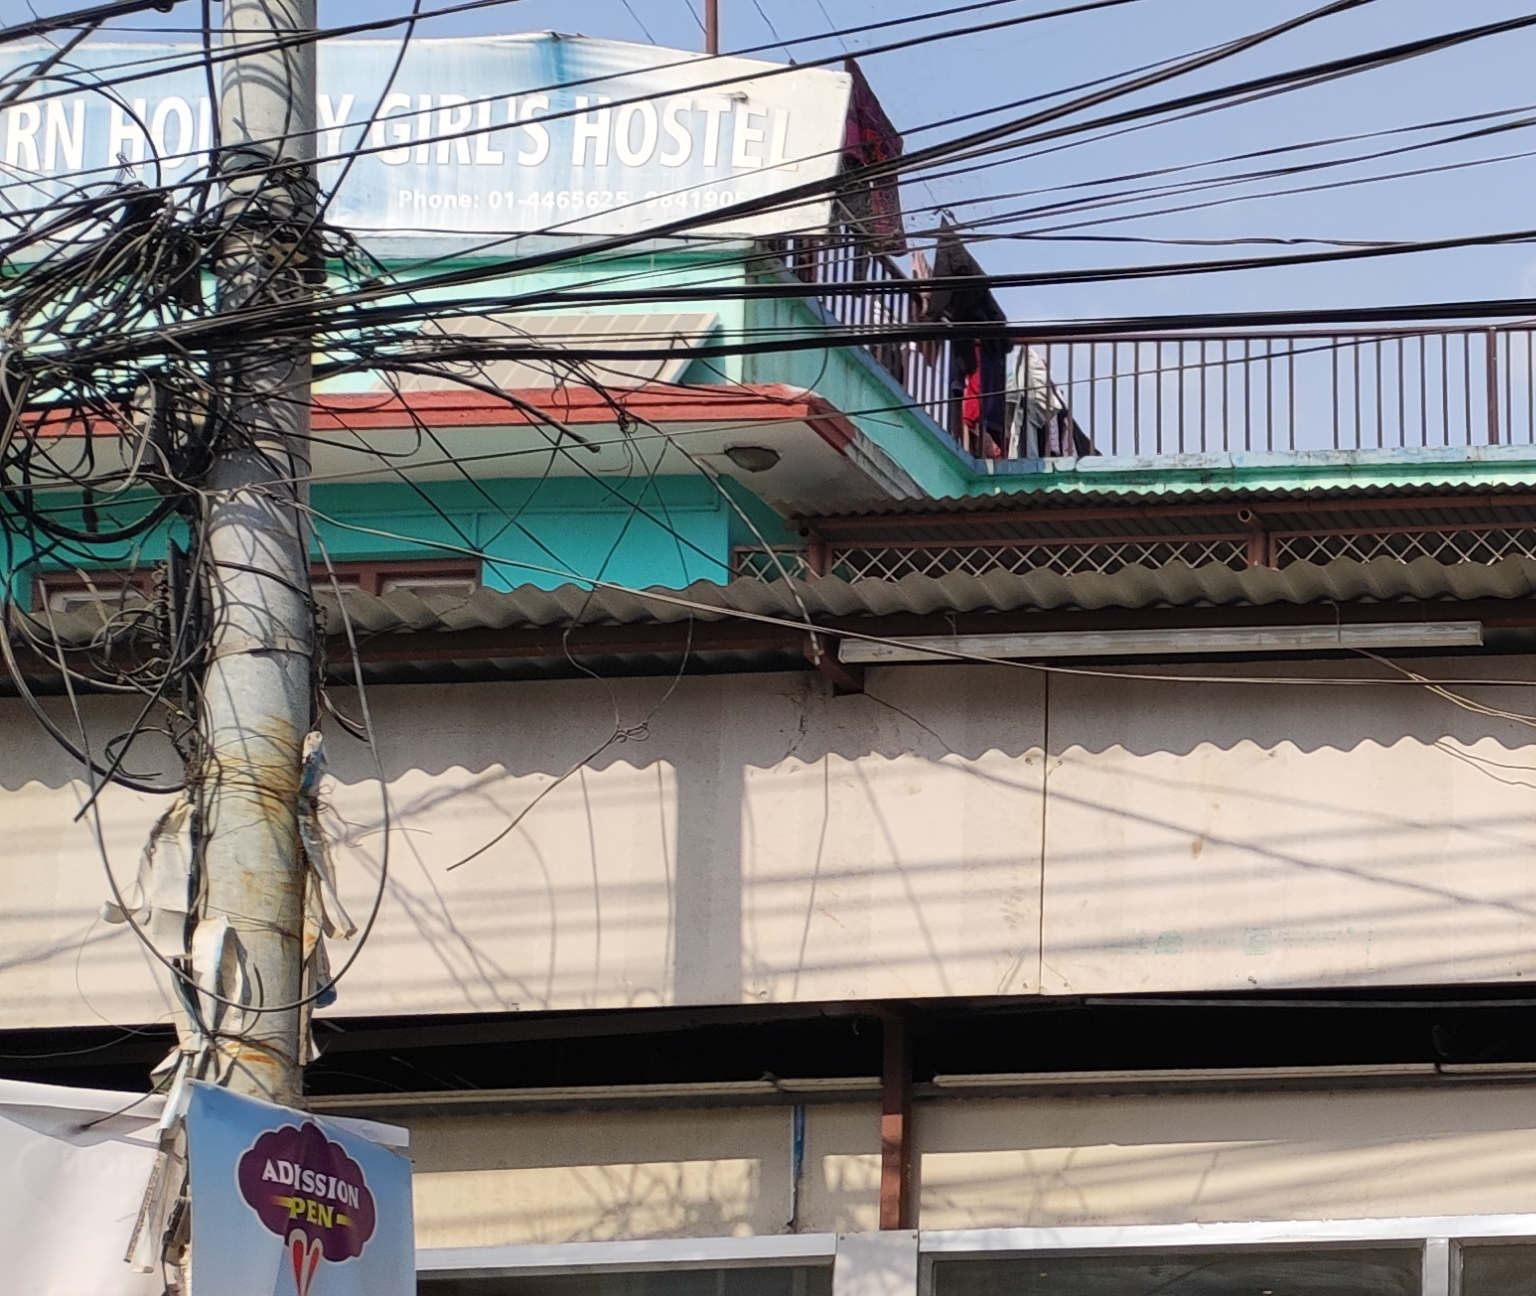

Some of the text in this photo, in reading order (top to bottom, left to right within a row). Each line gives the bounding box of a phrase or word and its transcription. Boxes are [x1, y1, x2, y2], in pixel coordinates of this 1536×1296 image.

[371, 93, 550, 167] GIRL'S
[571, 96, 800, 172] HOSTEL
[398, 189, 481, 211] Phone:
